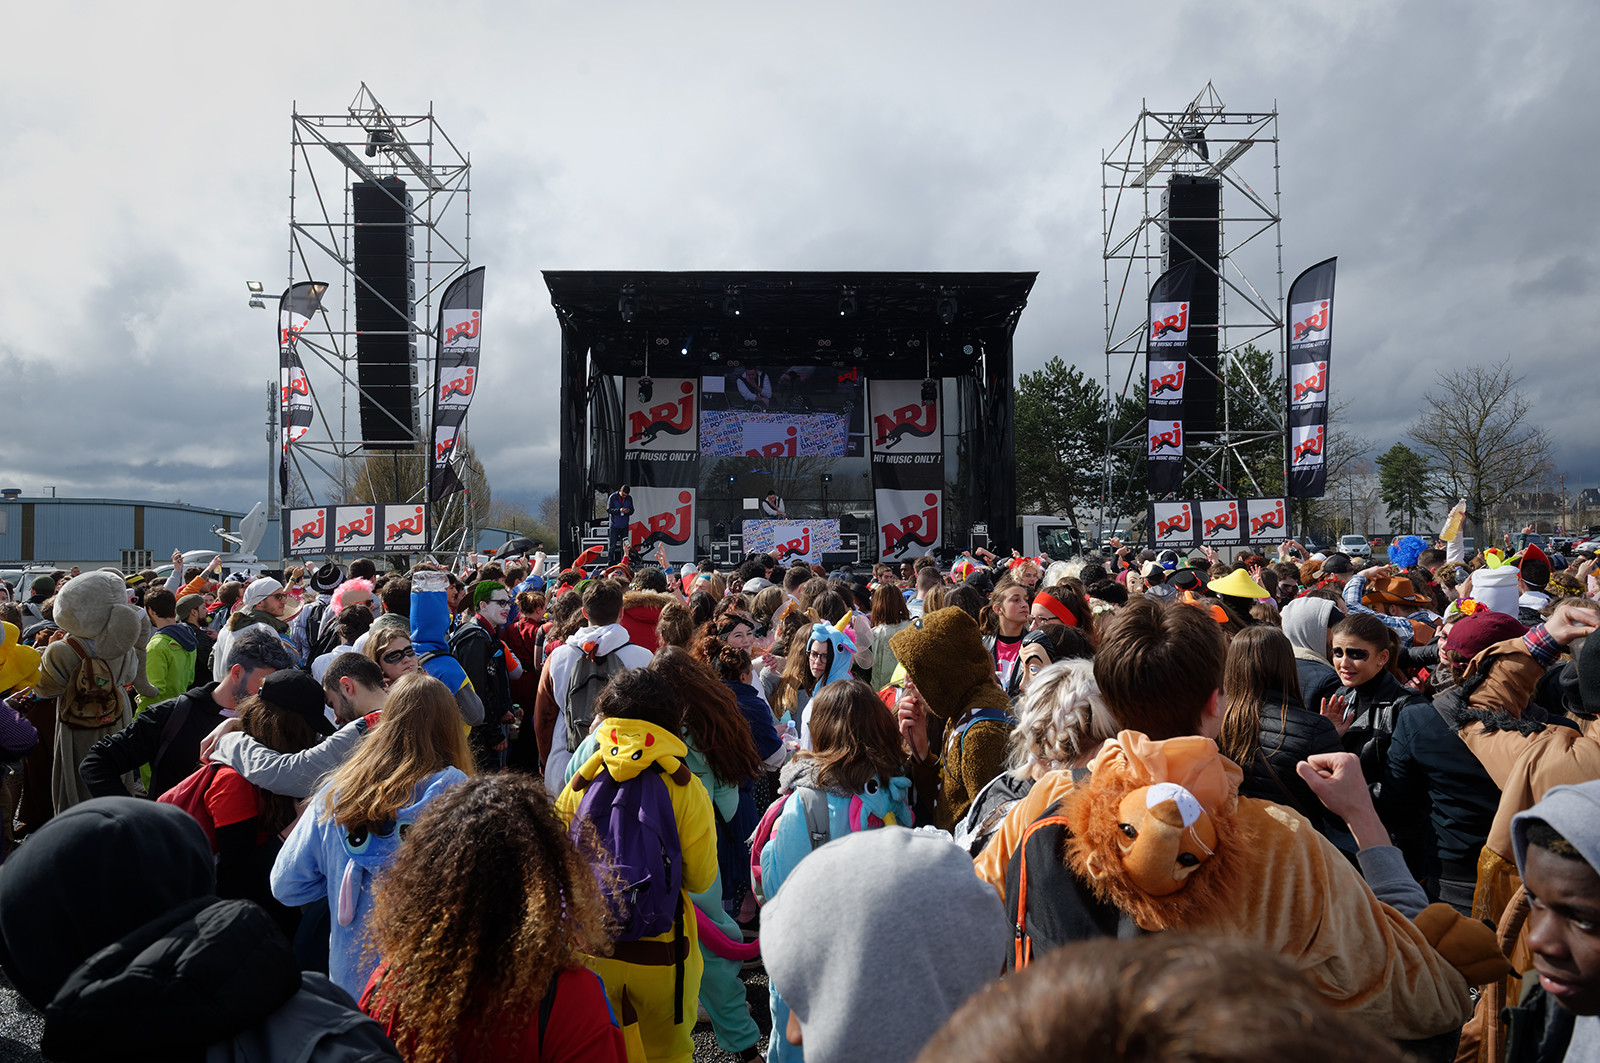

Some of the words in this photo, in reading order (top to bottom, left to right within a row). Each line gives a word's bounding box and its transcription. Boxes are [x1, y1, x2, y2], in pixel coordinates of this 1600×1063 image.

[625, 451, 639, 460] HIT
[640, 452, 668, 461] MUSIC
[669, 452, 692, 462] ONLY
[692, 452, 697, 462] !
[874, 454, 886, 462] HIT
[886, 455, 912, 464] MUSIC
[914, 456, 936, 464] ONLY
[937, 456, 941, 464] !
